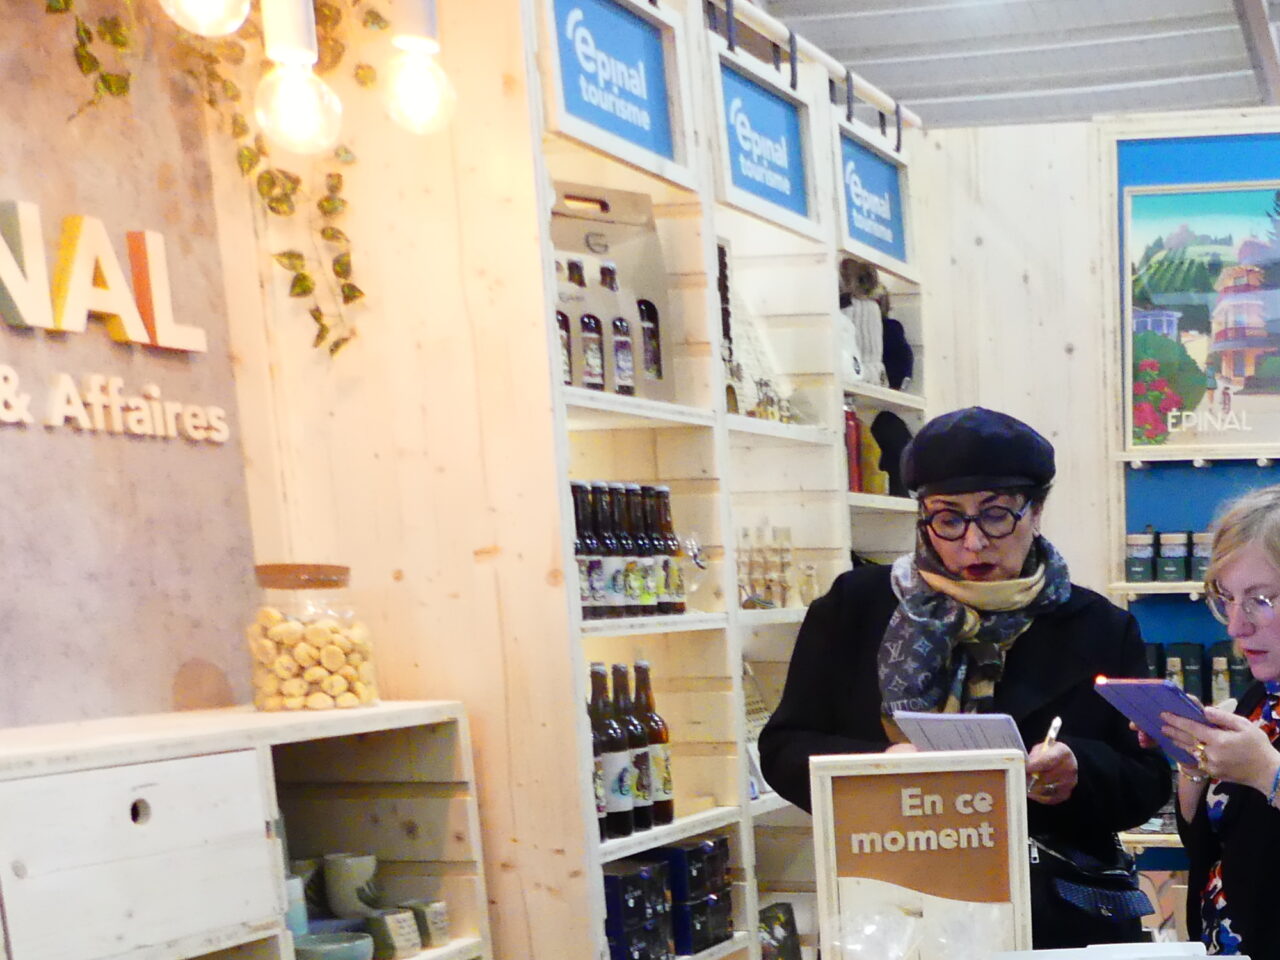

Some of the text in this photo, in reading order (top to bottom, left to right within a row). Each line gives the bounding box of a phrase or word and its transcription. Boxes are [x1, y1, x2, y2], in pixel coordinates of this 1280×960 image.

[579, 73, 650, 131] tourisme
[740, 153, 791, 195] tourisme
[852, 207, 893, 243] tourisme
[49, 372, 230, 443] Affaires
[1166, 408, 1253, 433] ÉPINAL
[901, 787, 993, 817] En ce
[851, 821, 995, 854] moment
